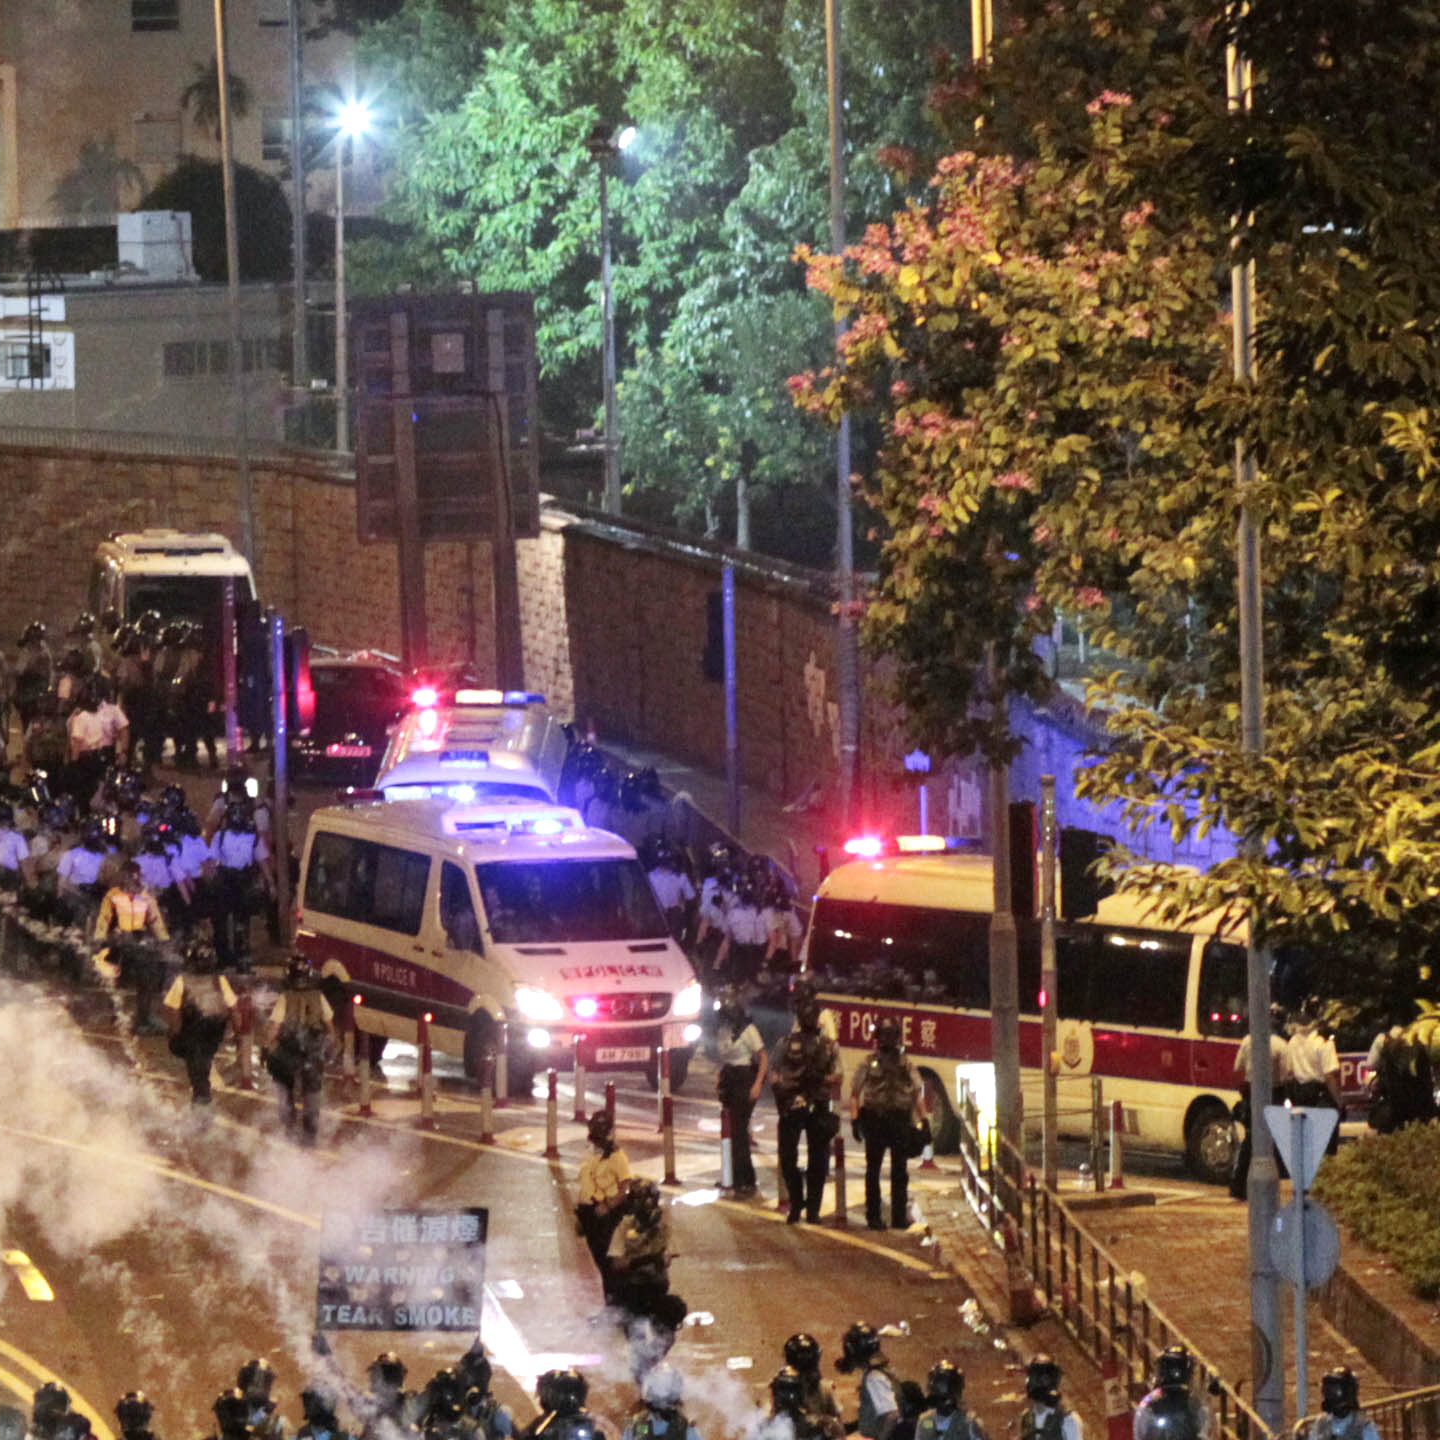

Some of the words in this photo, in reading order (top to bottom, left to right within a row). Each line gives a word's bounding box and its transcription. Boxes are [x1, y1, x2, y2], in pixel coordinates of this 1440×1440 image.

[343, 1264, 456, 1285] WARNING
[322, 1304, 384, 1325] TEAR
[393, 1305, 479, 1326] SMOKE
